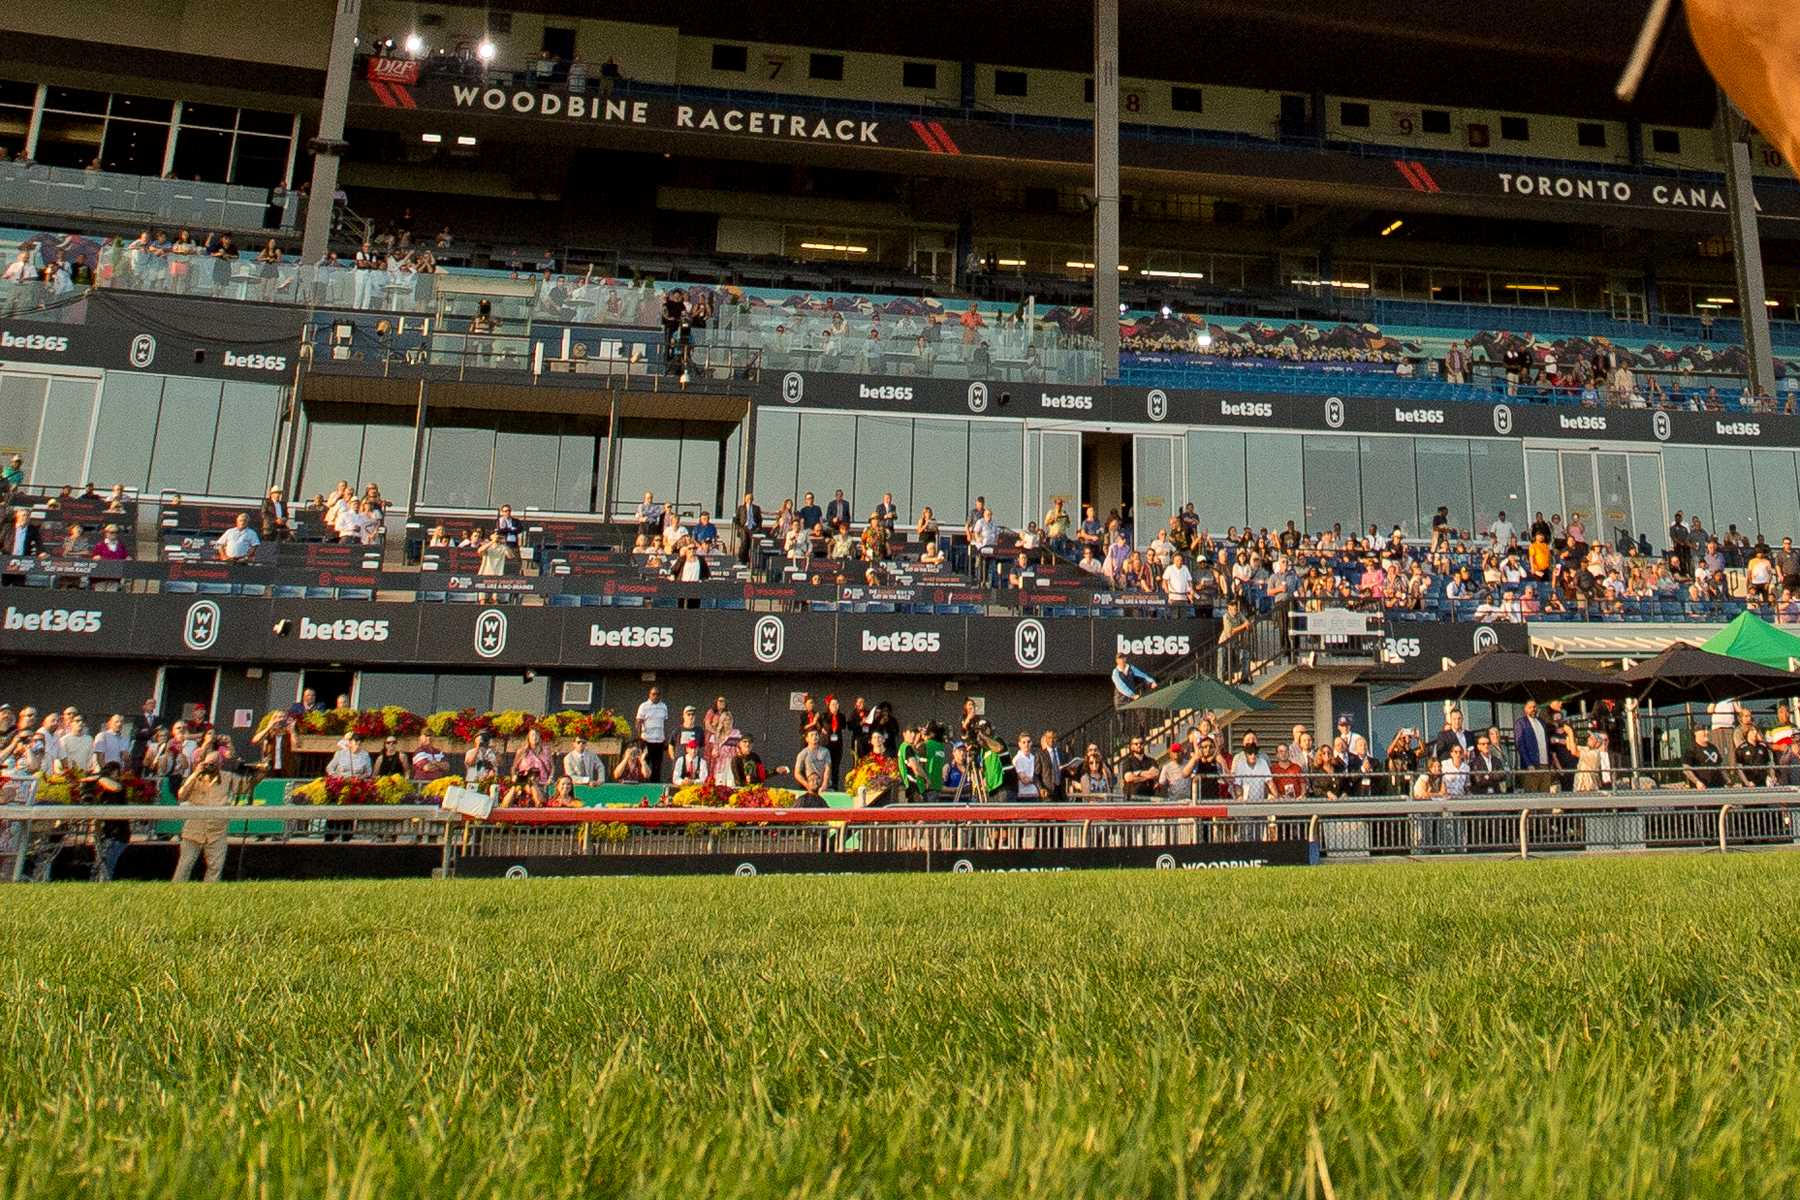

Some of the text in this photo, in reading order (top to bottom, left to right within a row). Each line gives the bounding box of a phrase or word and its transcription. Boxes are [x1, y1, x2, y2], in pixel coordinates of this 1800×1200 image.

[767, 61, 785, 80] 7
[1126, 94, 1140, 113] 8
[453, 85, 880, 144] WOODBINE RACETRACK
[1399, 117, 1414, 135] 9
[1499, 173, 1762, 212] TORONTO CANA
[1, 331, 69, 352] bet365
[223, 350, 287, 372] bet365
[859, 383, 914, 400] bet365
[1041, 393, 1093, 410] bet365
[1221, 400, 1273, 417] bet365
[1395, 408, 1445, 424] bet365
[1560, 414, 1607, 430] bet365
[1715, 421, 1761, 436] bet365
[4, 606, 102, 633] bet365
[299, 617, 390, 642] bet365
[590, 624, 674, 648] bet365
[861, 630, 941, 652] bet365
[1116, 634, 1191, 656] bet365
